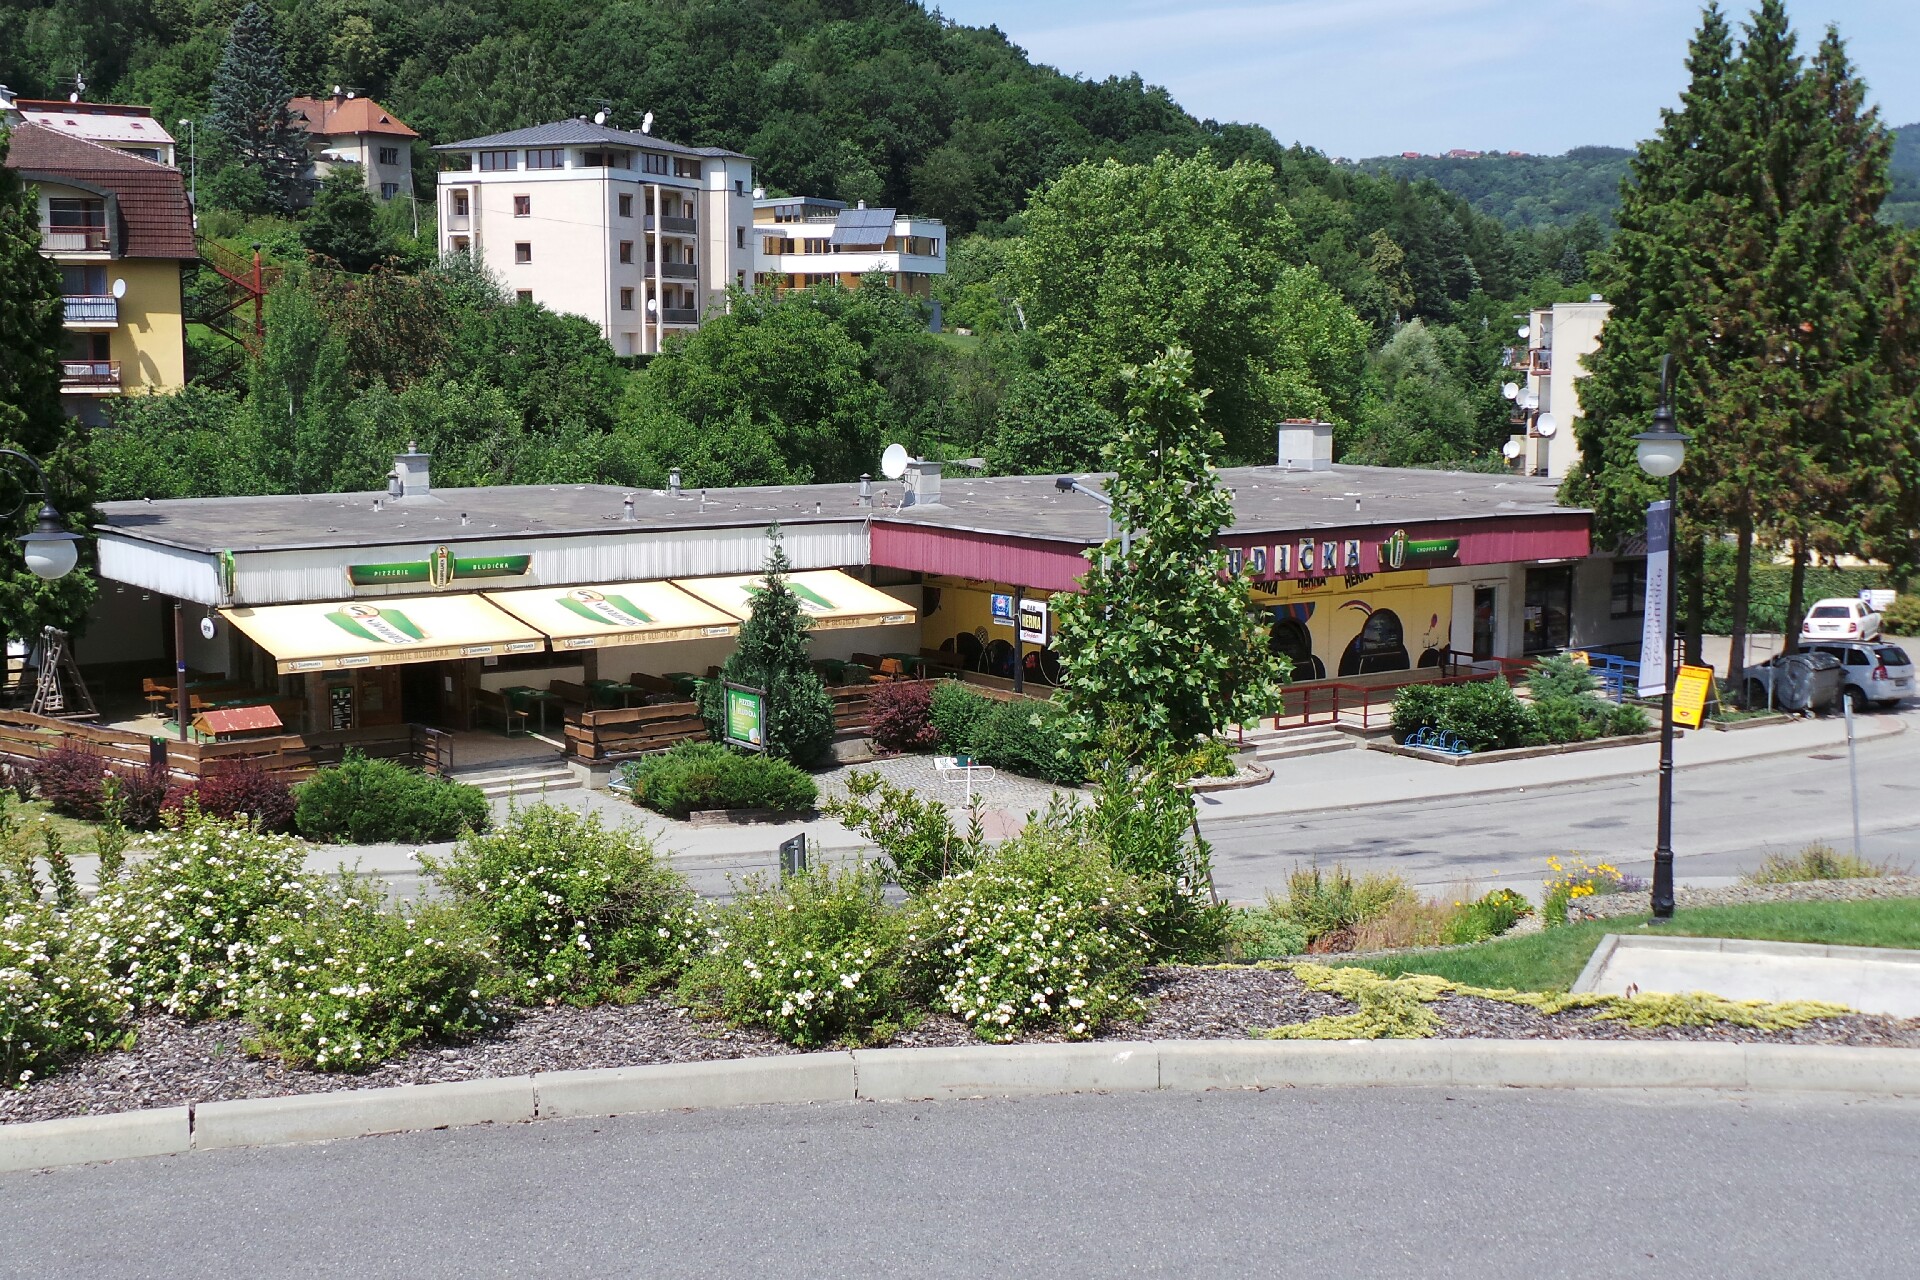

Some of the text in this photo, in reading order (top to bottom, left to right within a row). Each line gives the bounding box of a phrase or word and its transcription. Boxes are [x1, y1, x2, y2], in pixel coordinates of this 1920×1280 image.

[1226, 538, 1360, 576] UDIČKA
[472, 562, 509, 570] BLUDIČKA
[1021, 613, 1042, 630] HERNA
